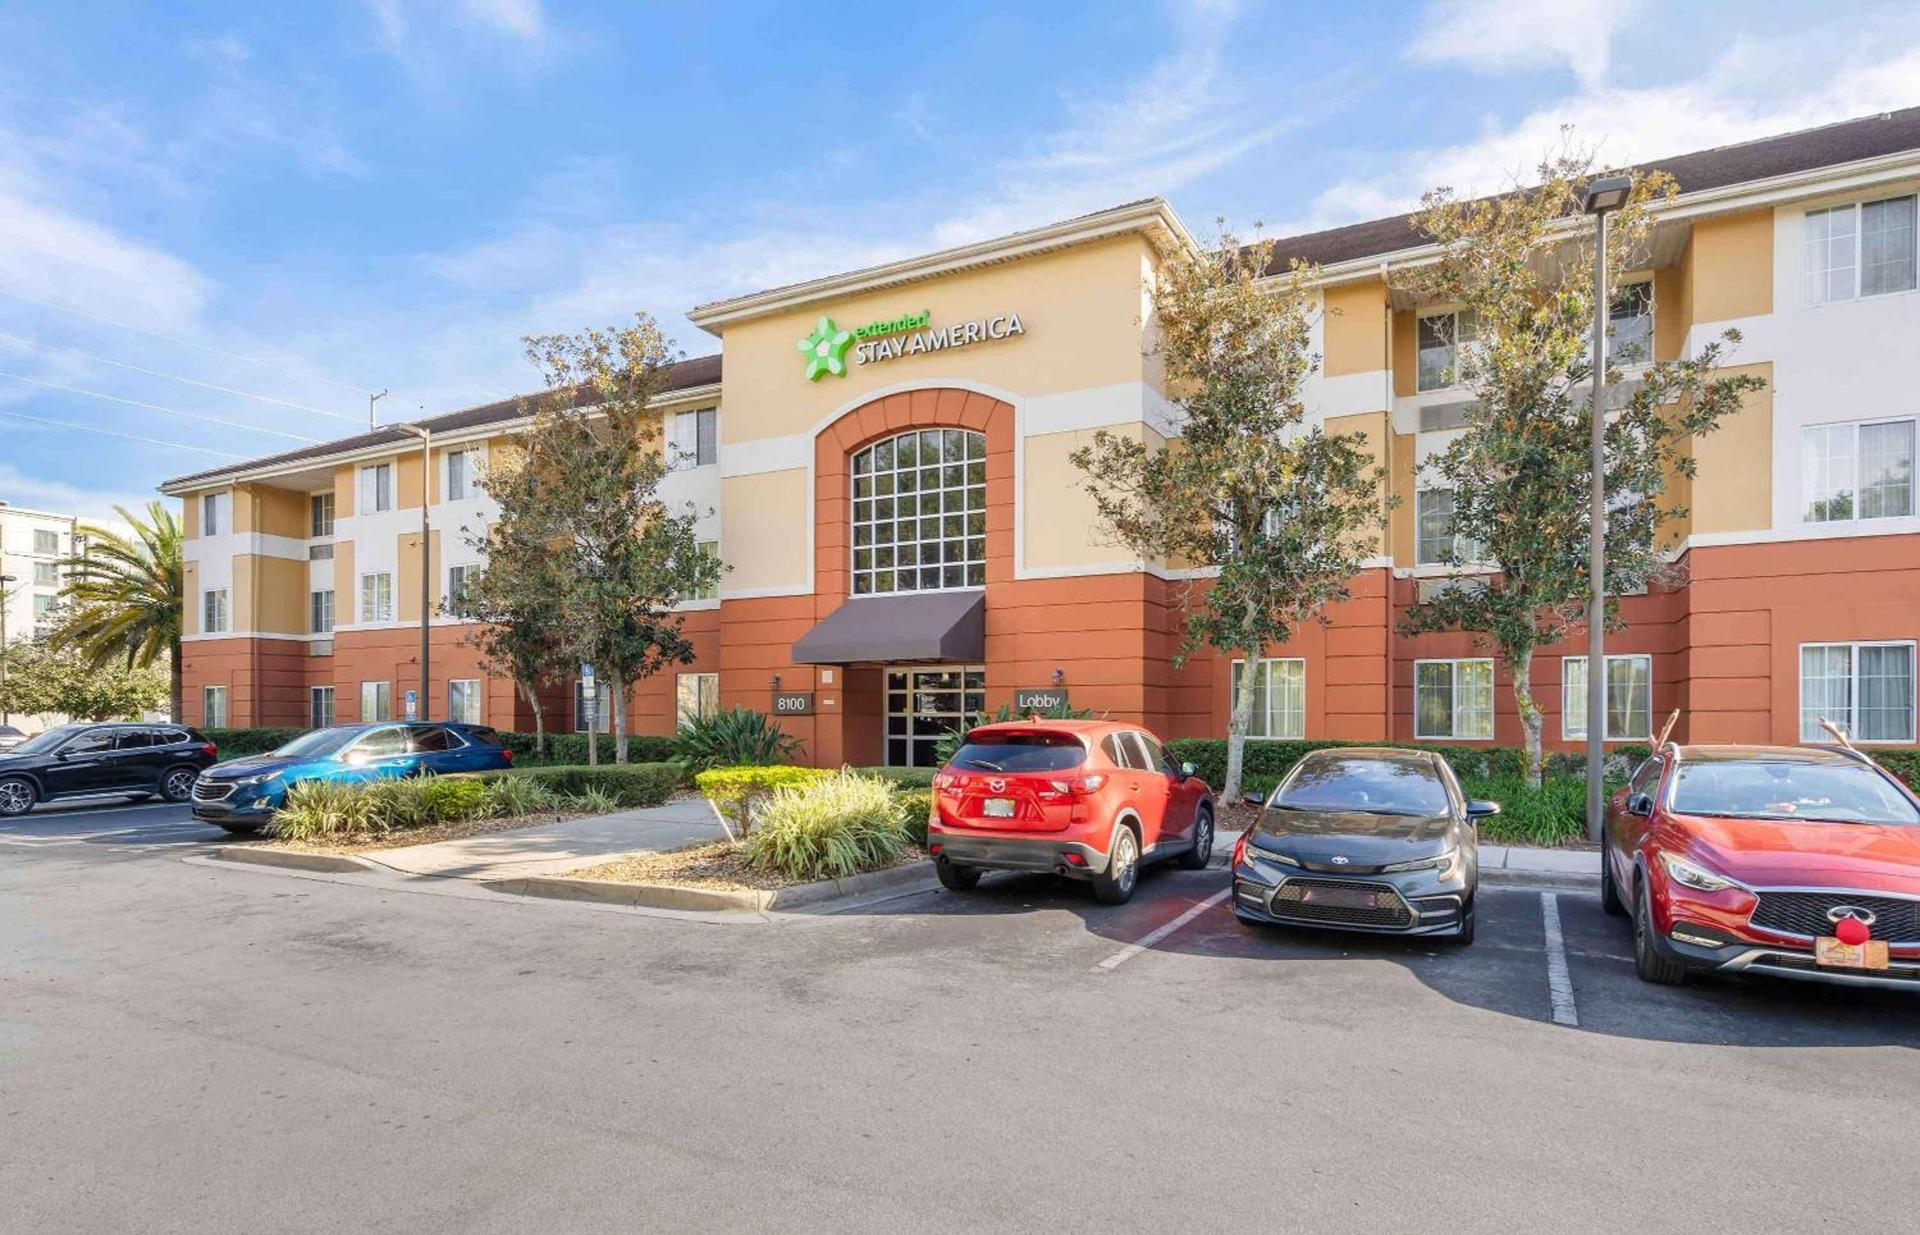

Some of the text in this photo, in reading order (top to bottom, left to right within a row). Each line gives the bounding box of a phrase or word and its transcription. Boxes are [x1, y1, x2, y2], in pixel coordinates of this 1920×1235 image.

[855, 309, 930, 338] extended
[855, 312, 1025, 365] STAY AMERICA
[778, 697, 805, 710] 8100
[1019, 694, 1061, 710] Lobby
